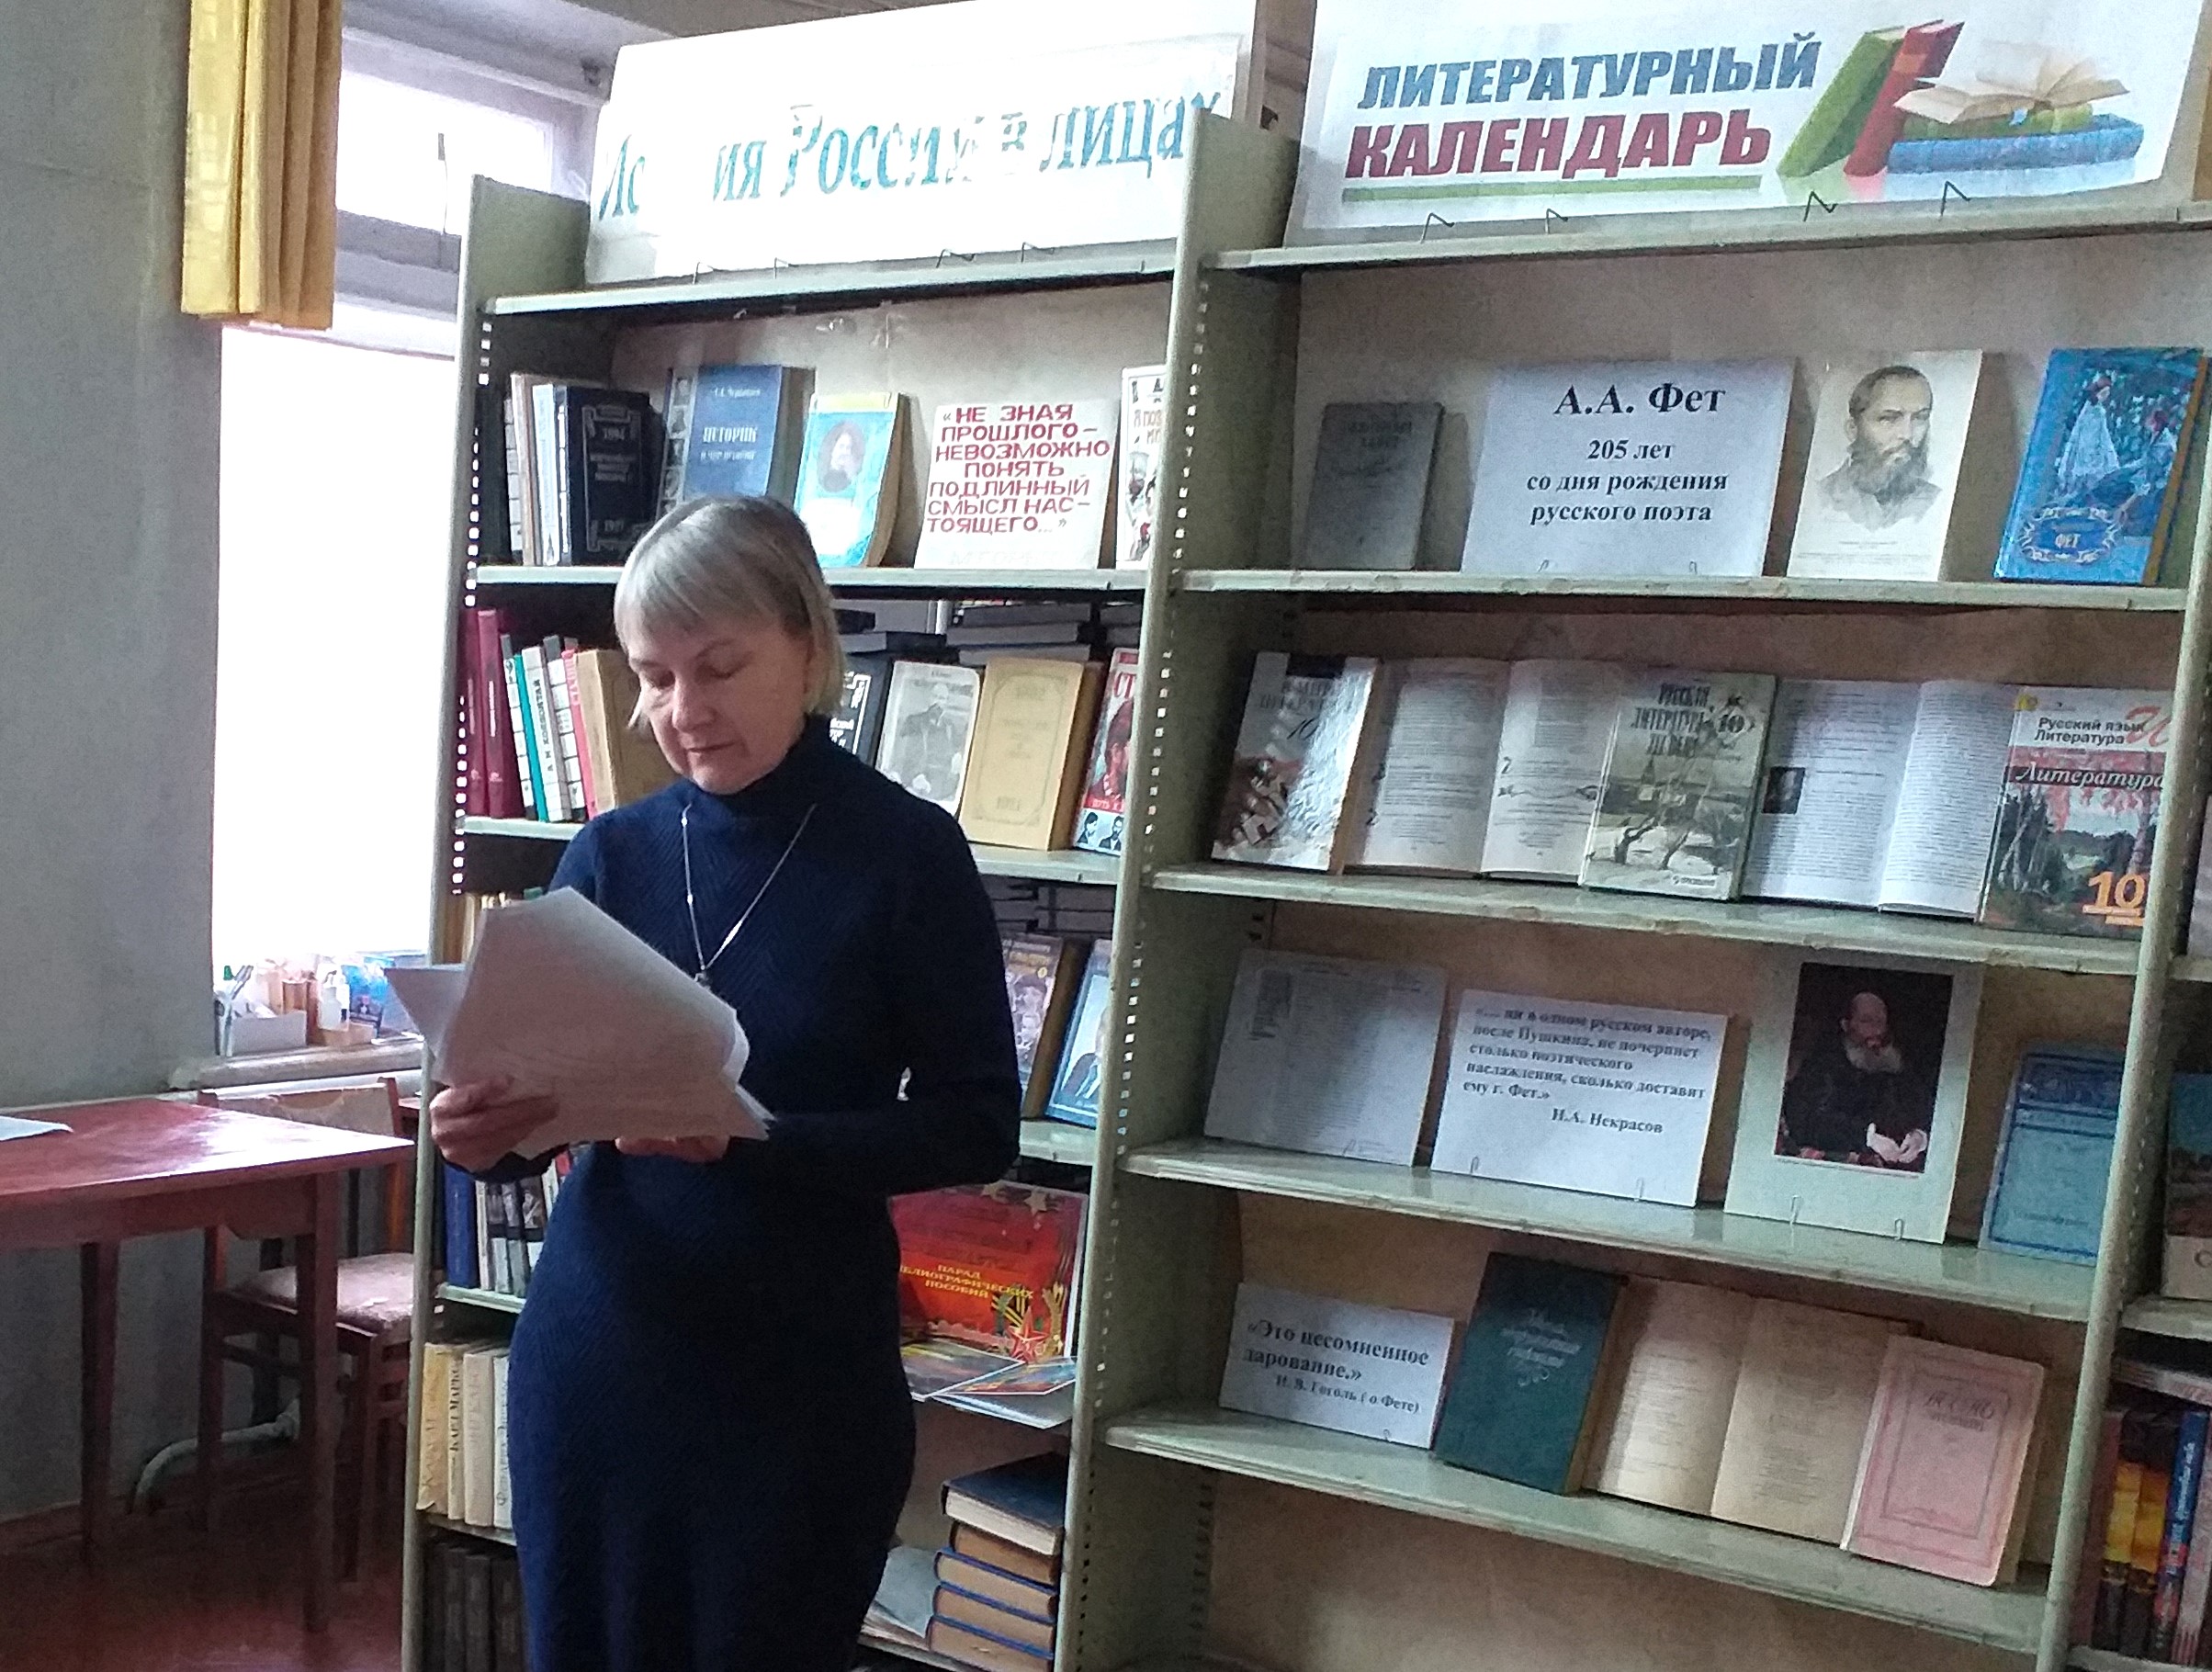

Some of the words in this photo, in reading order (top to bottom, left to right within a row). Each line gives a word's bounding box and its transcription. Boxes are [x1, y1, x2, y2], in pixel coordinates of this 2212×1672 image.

[1358, 31, 1823, 109] ЛИТЕРАТУРНЫЙ
[1345, 109, 1771, 178] КАЛЕНДАРЬ
[1553, 384, 1634, 414] А.А.
[1649, 382, 1726, 412] Фет
[1000, 404, 1073, 422] ЗНАЯ
[942, 424, 1078, 443] ПРОШЛОГО
[935, 440, 1111, 462] НЕВОЗМОЖНО
[1587, 439, 1630, 459] 205
[1633, 444, 1675, 459] лет
[965, 461, 1064, 479] ПОНЯТЬ
[929, 474, 1090, 500] ПОДЛИННЫЙ
[1527, 475, 1551, 491] со
[1556, 476, 1600, 491] дня
[1607, 473, 1729, 495] рождения
[928, 499, 1018, 516] СМЫСЛ
[1530, 505, 1636, 526] русского
[1642, 505, 1712, 521] поэта
[2038, 717, 2102, 732] Русский
[2105, 720, 2145, 733] язык
[2034, 729, 2125, 746] Литература
[2087, 870, 2146, 909] 10
[1539, 1012, 1587, 1027] одном
[1590, 1018, 1653, 1035] русском
[1473, 1024, 1514, 1039] после
[1518, 1026, 1594, 1048] Пушкина,
[1598, 1038, 1615, 1050] не
[1469, 1043, 1528, 1059] столько
[1531, 1049, 1633, 1071] поэтического
[1463, 1081, 1489, 1096] ему
[1492, 1083, 1504, 1095] г.
[1467, 1062, 1566, 1085] наслаждения,
[1570, 1073, 1633, 1091] сколько
[1636, 1080, 1707, 1100] доставит
[1589, 1112, 1665, 1135] Некрасов
[937, 1264, 981, 1279] ПАРАД
[925, 1279, 989, 1299] ПОСОБИЙ
[1247, 1319, 1296, 1342] «Это
[1301, 1331, 1430, 1366] несомненное
